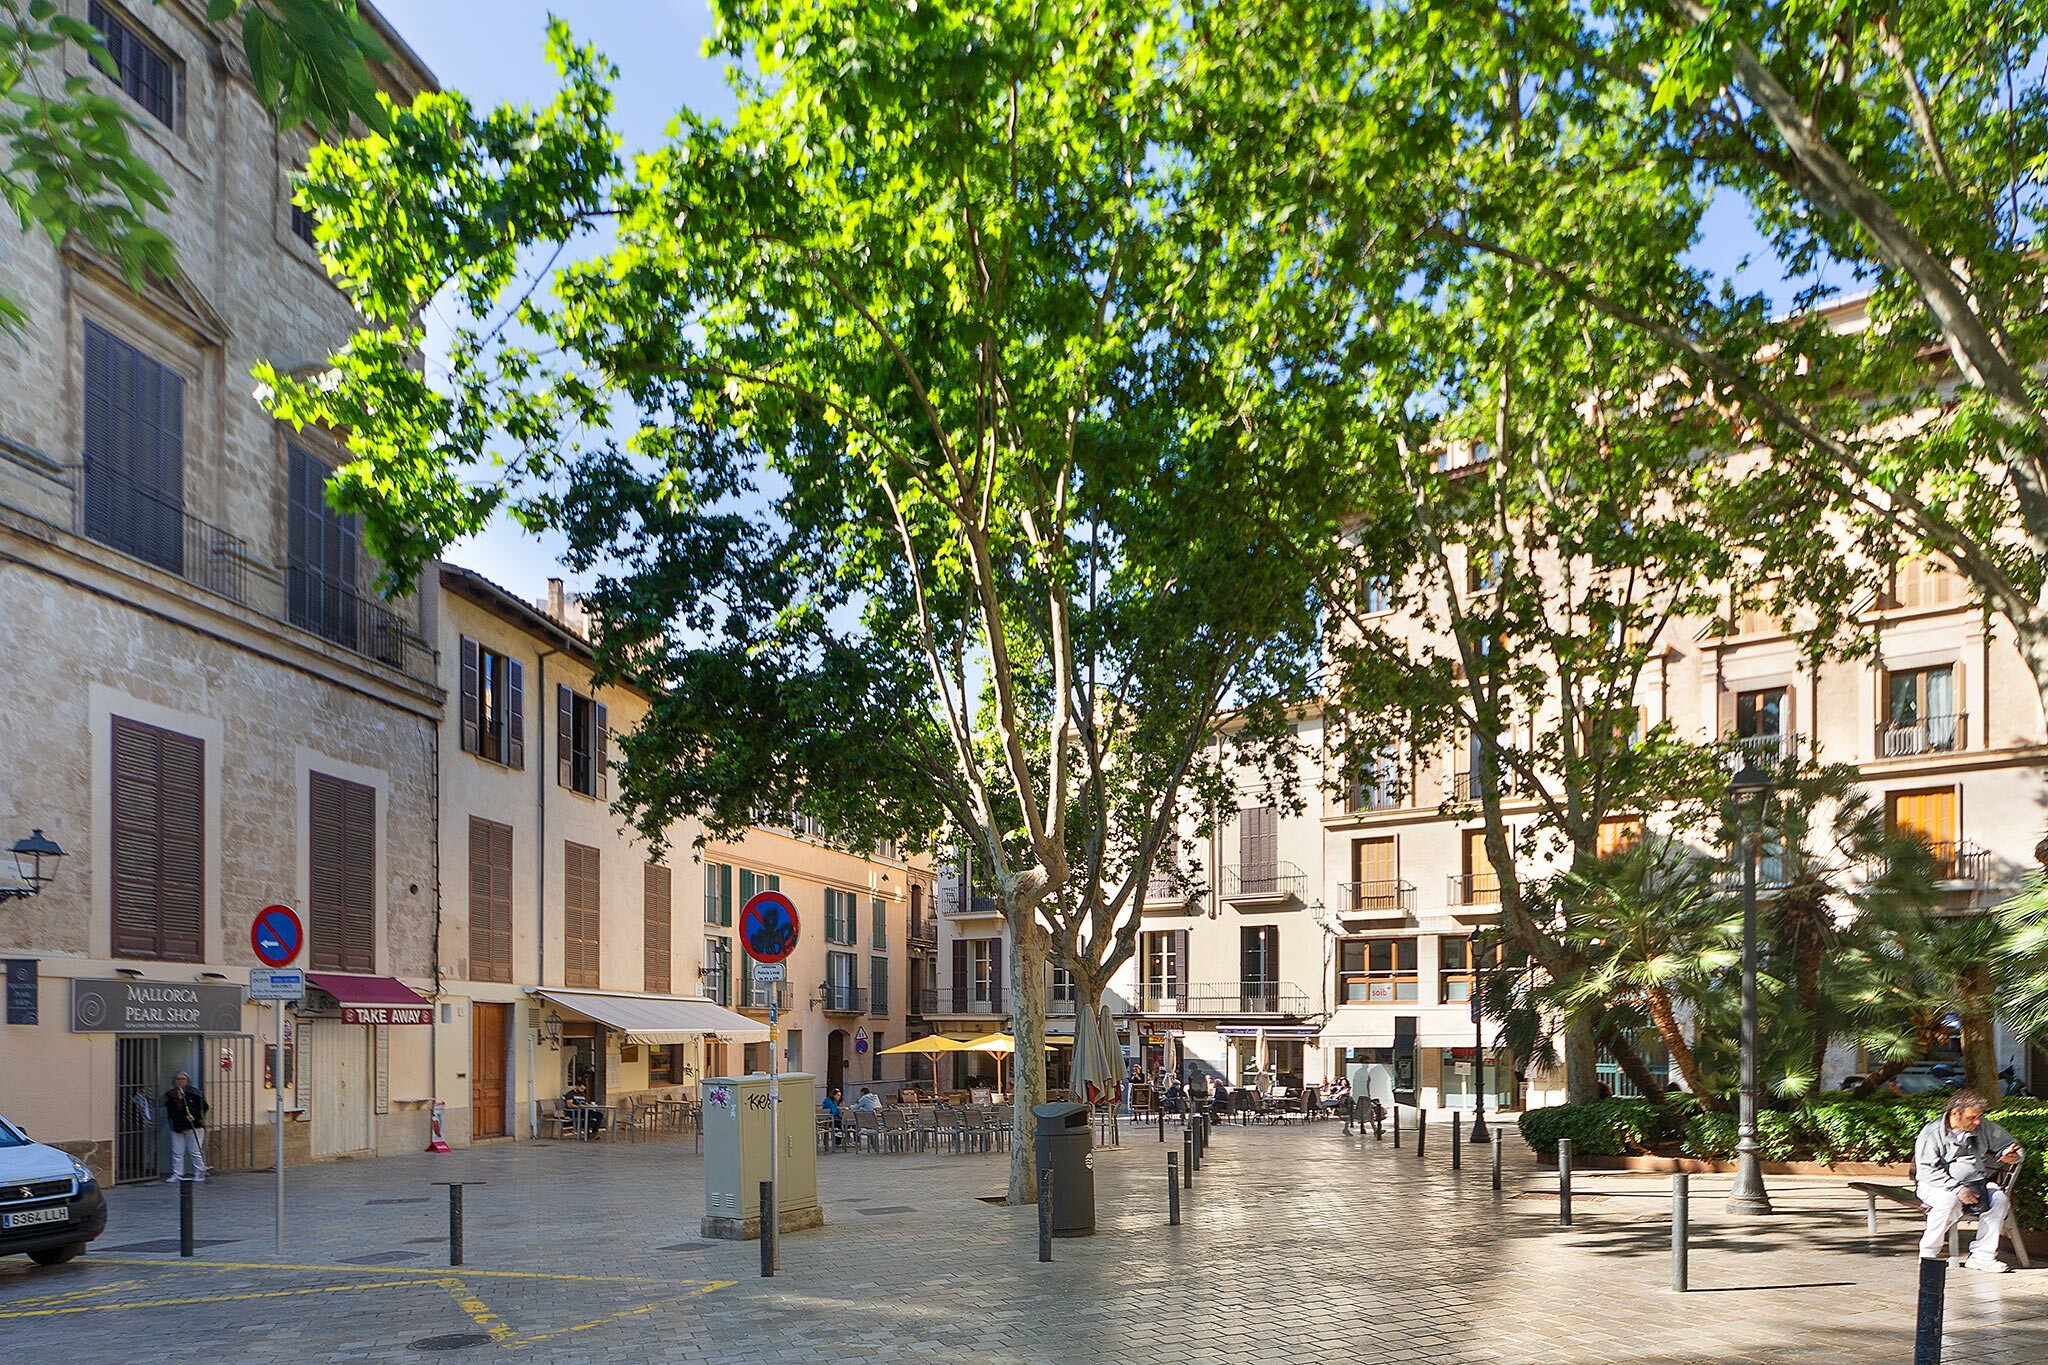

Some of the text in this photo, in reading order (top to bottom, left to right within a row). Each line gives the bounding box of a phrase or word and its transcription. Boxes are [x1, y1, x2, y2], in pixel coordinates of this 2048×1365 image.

[126, 984, 199, 1004] MALLORCA
[1371, 988, 1388, 997] soib
[125, 1006, 200, 1022] PEARL SHOP
[355, 1008, 421, 1024] TAKE AWAY
[1153, 1022, 1182, 1032] TABACOS
[12, 1209, 67, 1225] 6364 LLH
